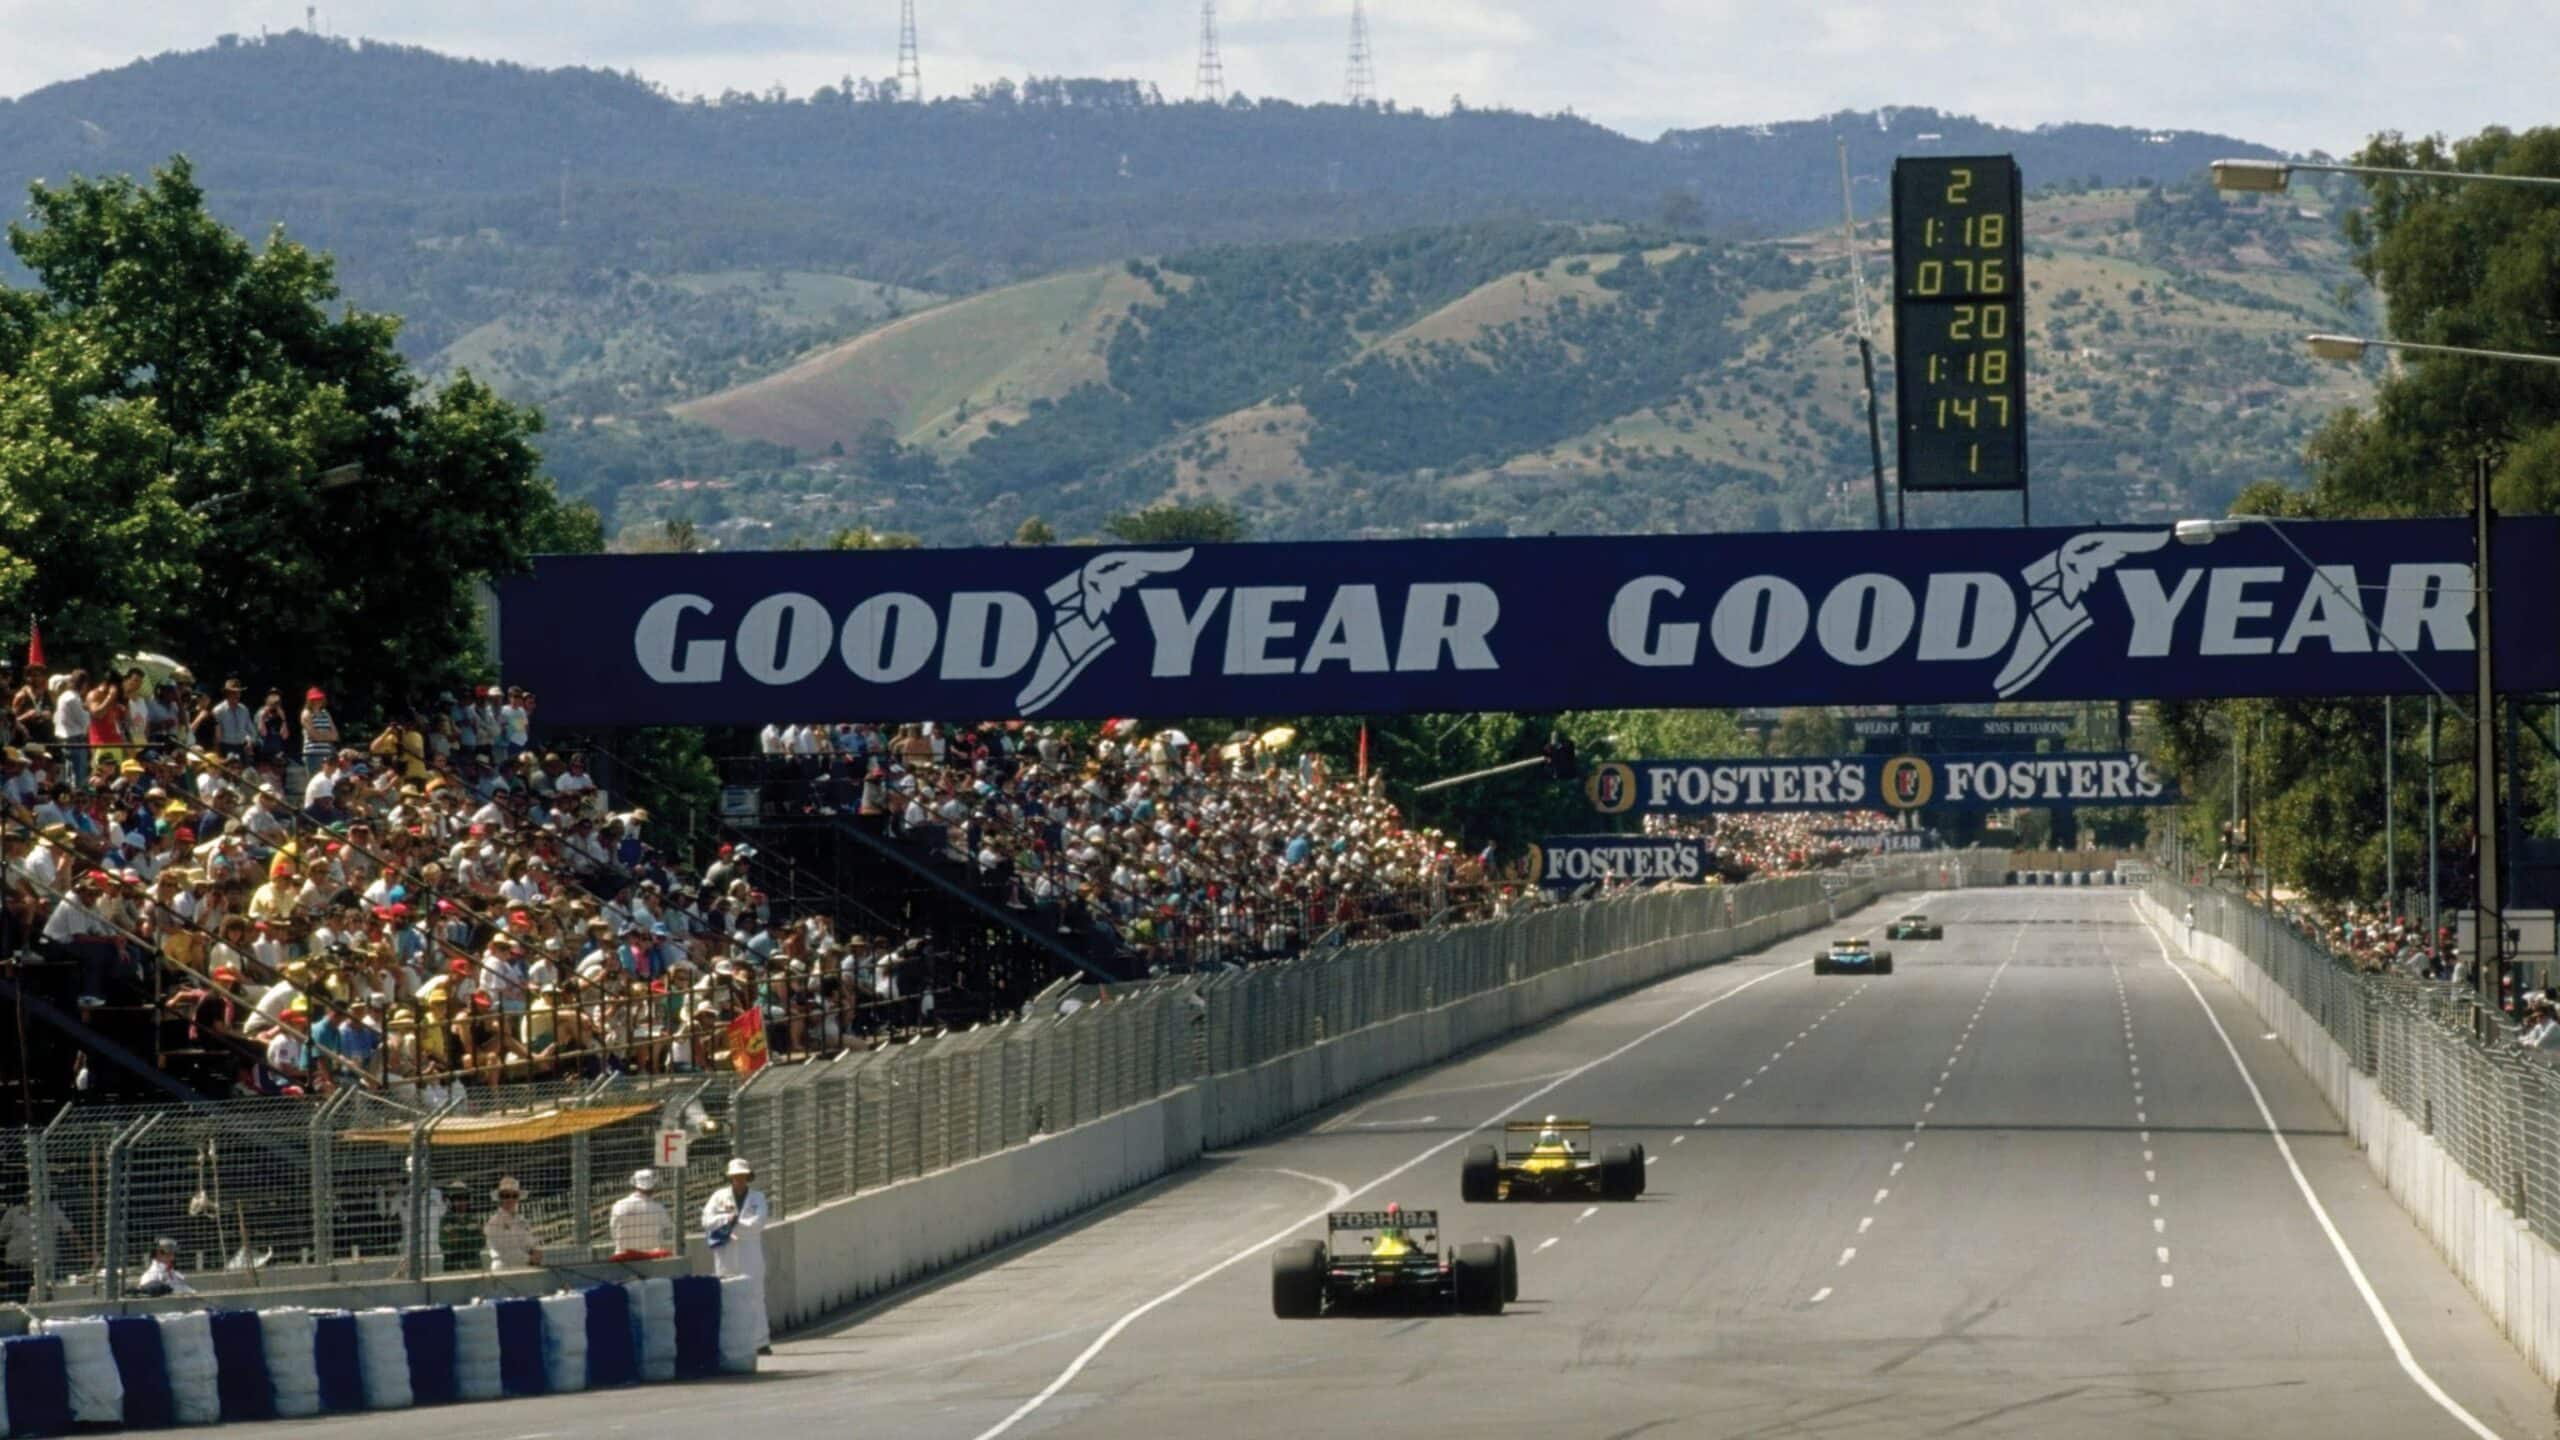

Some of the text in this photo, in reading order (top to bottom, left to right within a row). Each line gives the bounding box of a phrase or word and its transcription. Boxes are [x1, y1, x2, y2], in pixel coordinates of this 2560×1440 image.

[1947, 168, 1971, 203] 2
[1925, 213, 2004, 248] 1:18
[1950, 305, 2006, 340] 20
[1929, 350, 2007, 385] 1:18
[1970, 443, 1979, 474] 1
[1608, 563, 2477, 669] GOOD YEAR
[634, 582, 1500, 686] GOOD YEAR
[1648, 759, 1865, 805] FOSTER'S
[1945, 754, 2162, 801] FOSTER'S
[1546, 842, 1699, 879] FOSTER'S
[663, 1134, 682, 1163] F
